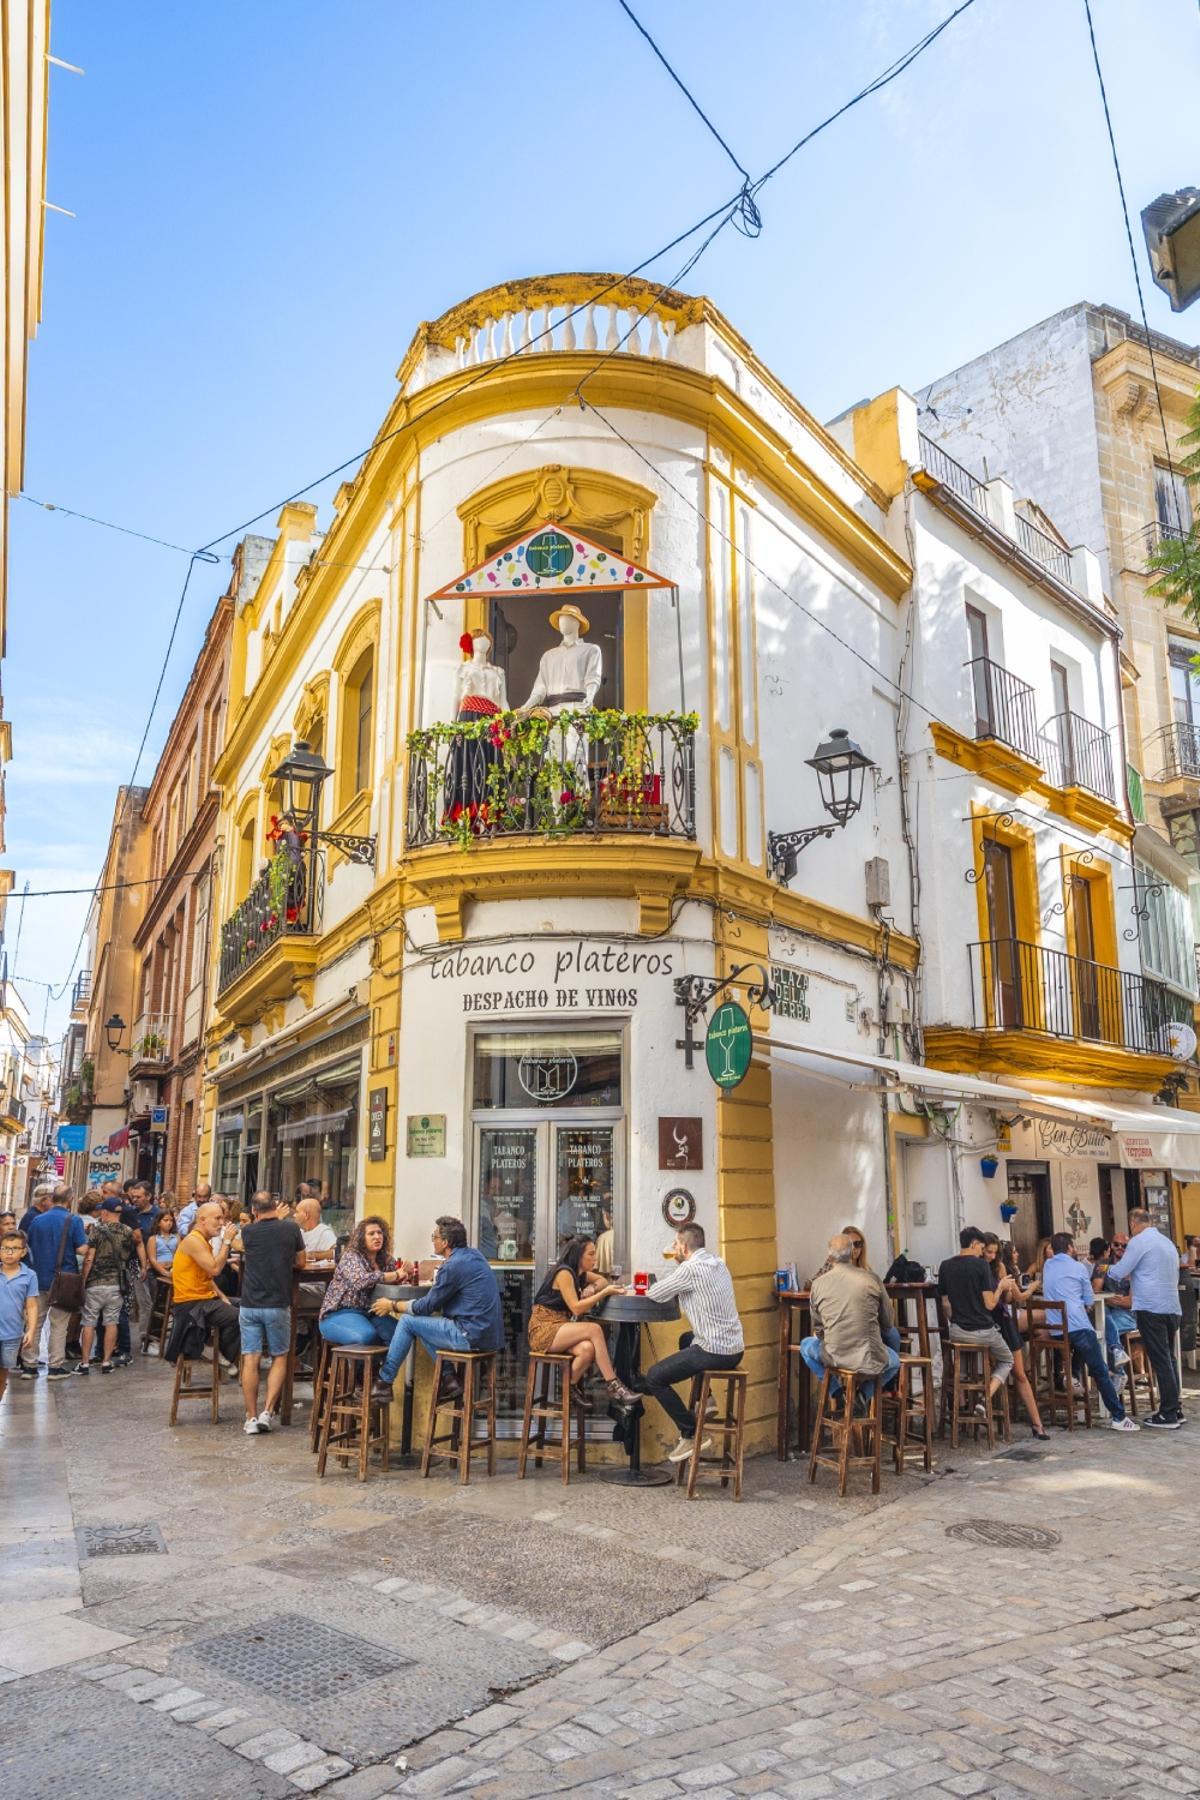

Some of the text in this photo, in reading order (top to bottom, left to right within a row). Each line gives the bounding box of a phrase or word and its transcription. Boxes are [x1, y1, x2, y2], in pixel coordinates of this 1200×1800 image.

[430, 941, 674, 983] tabanco plateros
[773, 967, 809, 990] PLAZA
[462, 987, 638, 1012] DESPACHO DE VINOS
[775, 1000, 811, 1022] YERBA
[493, 1145, 526, 1156] TABANCO
[569, 1144, 601, 1155] TABANCO
[491, 1158, 526, 1169] PLATEROS
[568, 1158, 603, 1168] PLATEROS
